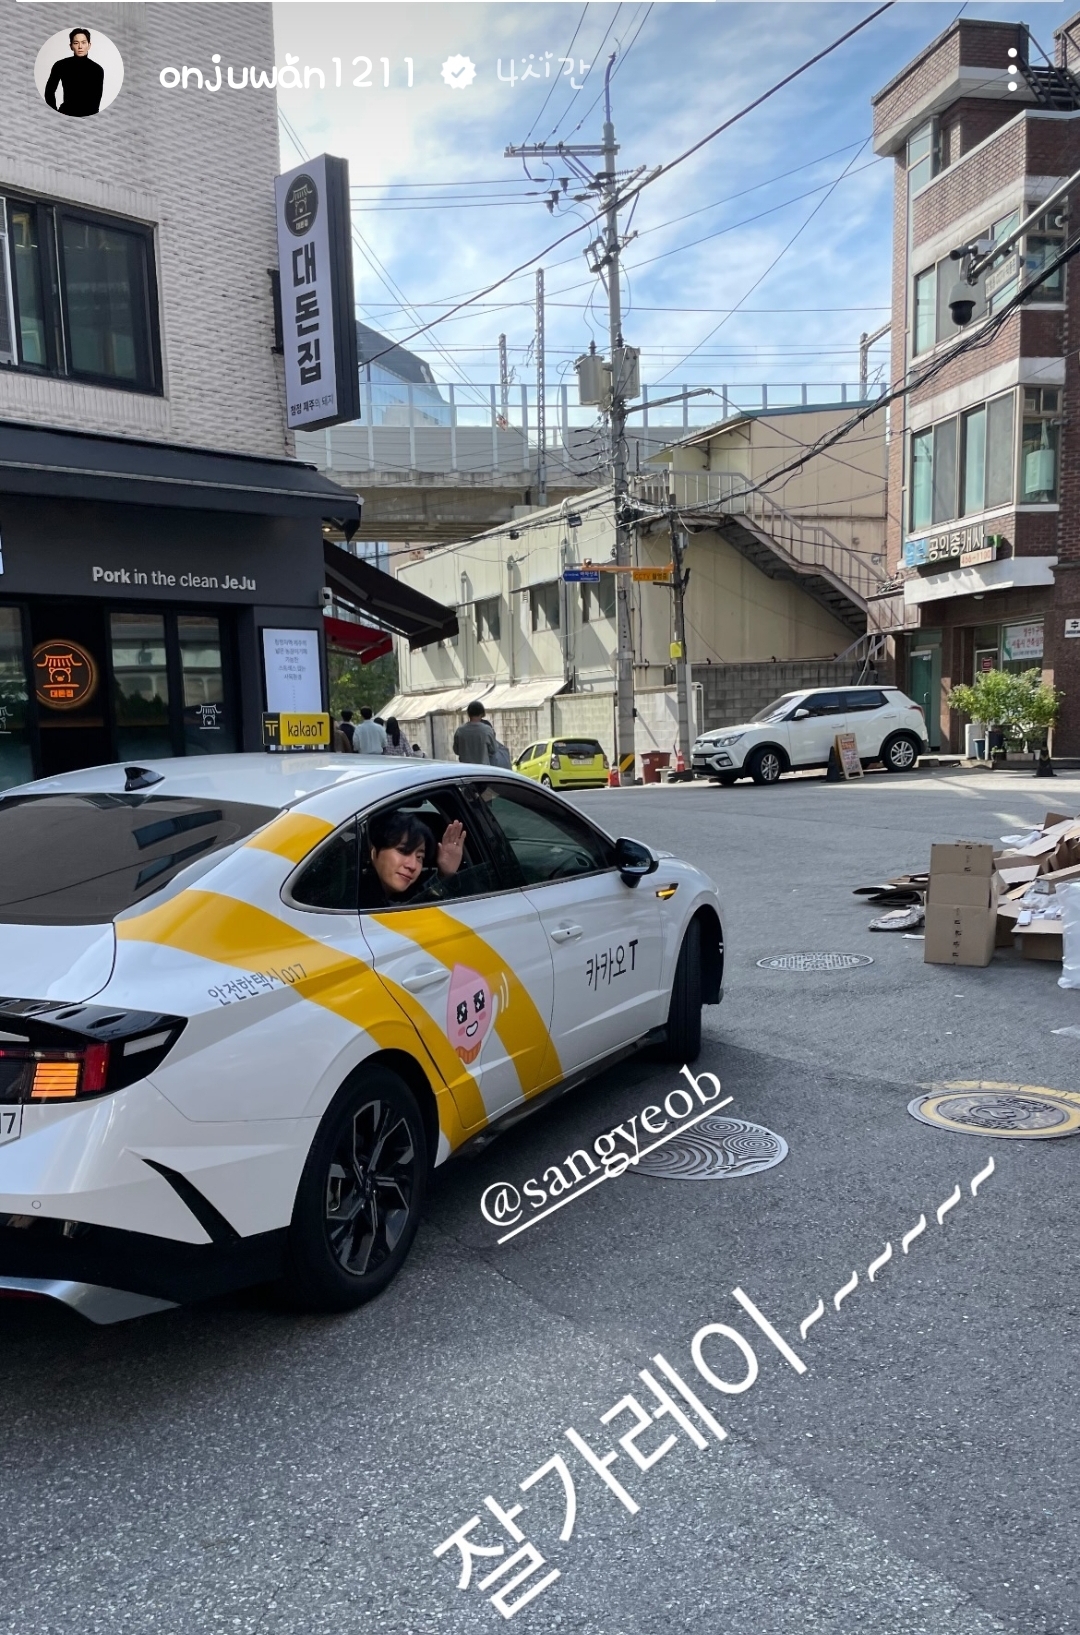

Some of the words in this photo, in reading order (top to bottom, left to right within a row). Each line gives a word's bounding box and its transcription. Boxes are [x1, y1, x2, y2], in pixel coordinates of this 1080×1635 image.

[291, 241, 322, 386] 대돈집
[928, 524, 985, 561] 공인중개사
[92, 566, 131, 584] Pork
[133, 568, 148, 585] in
[151, 571, 176, 587] the
[179, 572, 219, 589] clean
[220, 575, 257, 591] JeJu
